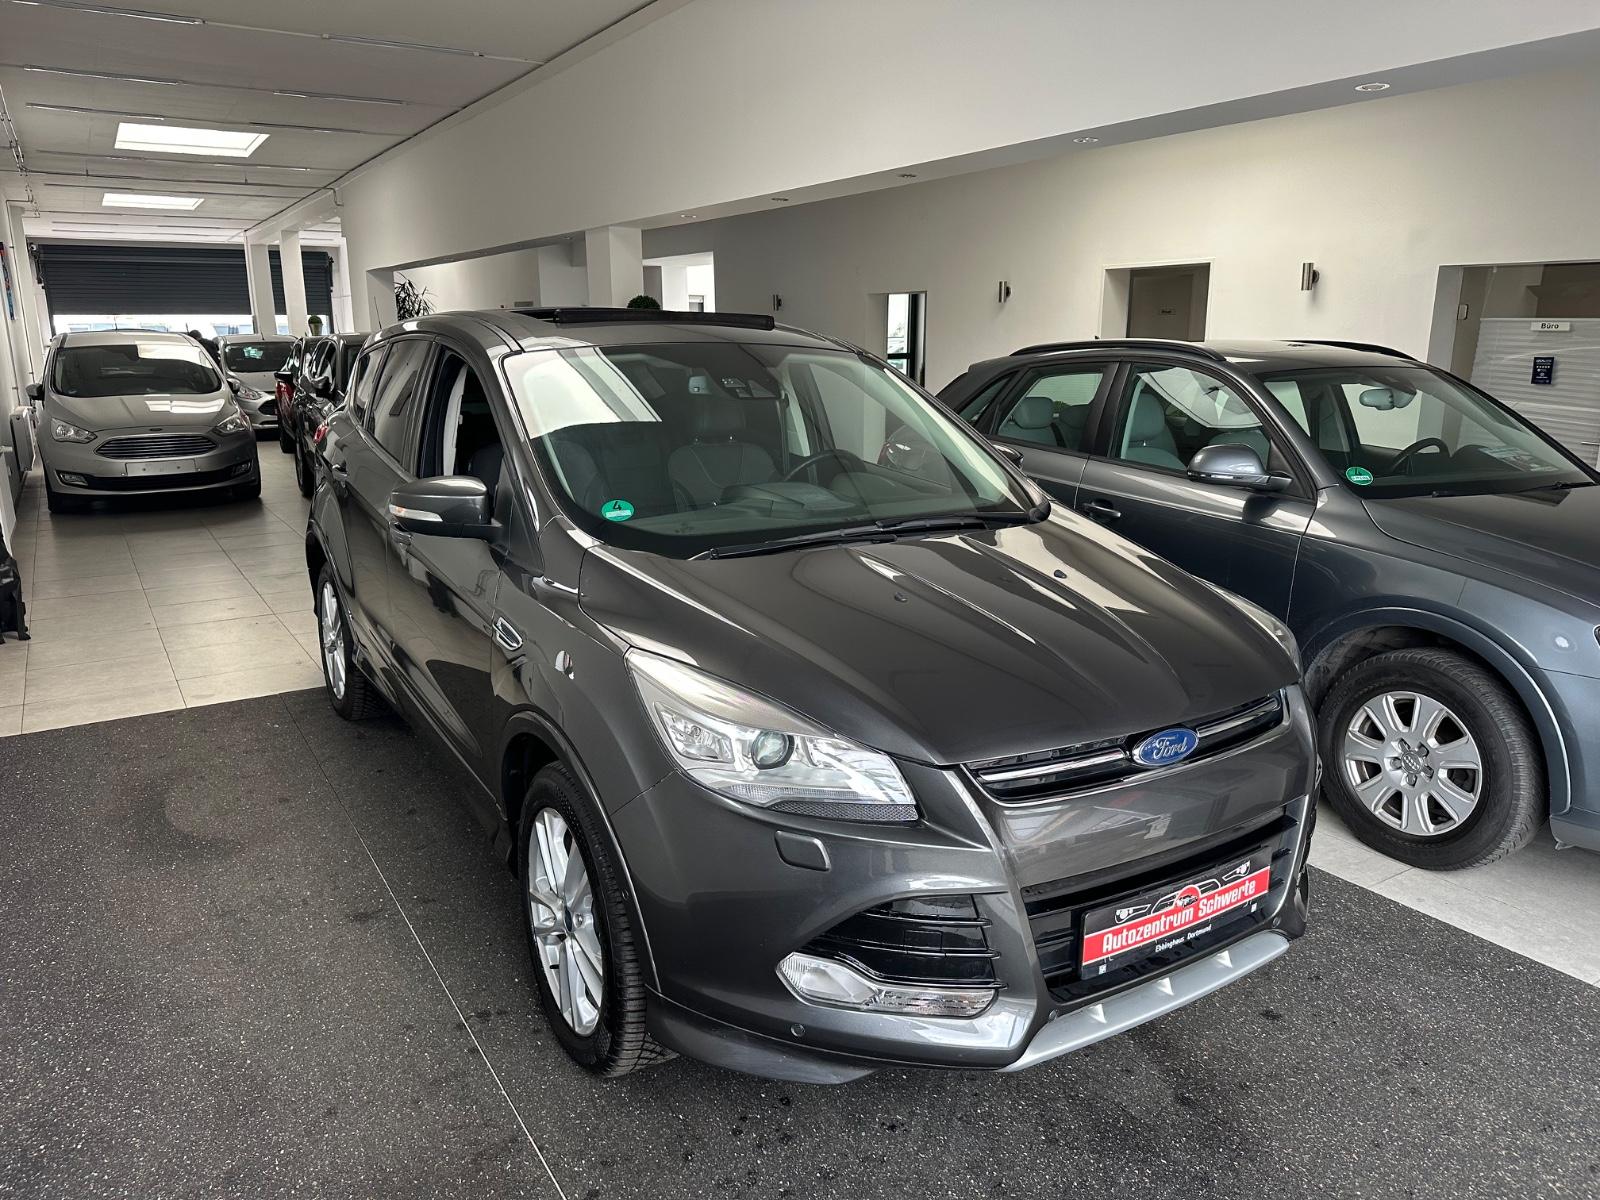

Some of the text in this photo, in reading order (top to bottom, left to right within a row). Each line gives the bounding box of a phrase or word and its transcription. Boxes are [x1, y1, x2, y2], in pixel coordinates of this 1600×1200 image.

[1541, 322, 1559, 330] Büro
[613, 501, 622, 511] 4
[1153, 735, 1188, 760] Ford
[1102, 880, 1256, 953] Autozentrum Schwerte
[1155, 923, 1212, 953] Ebbinghaus Dortmund
